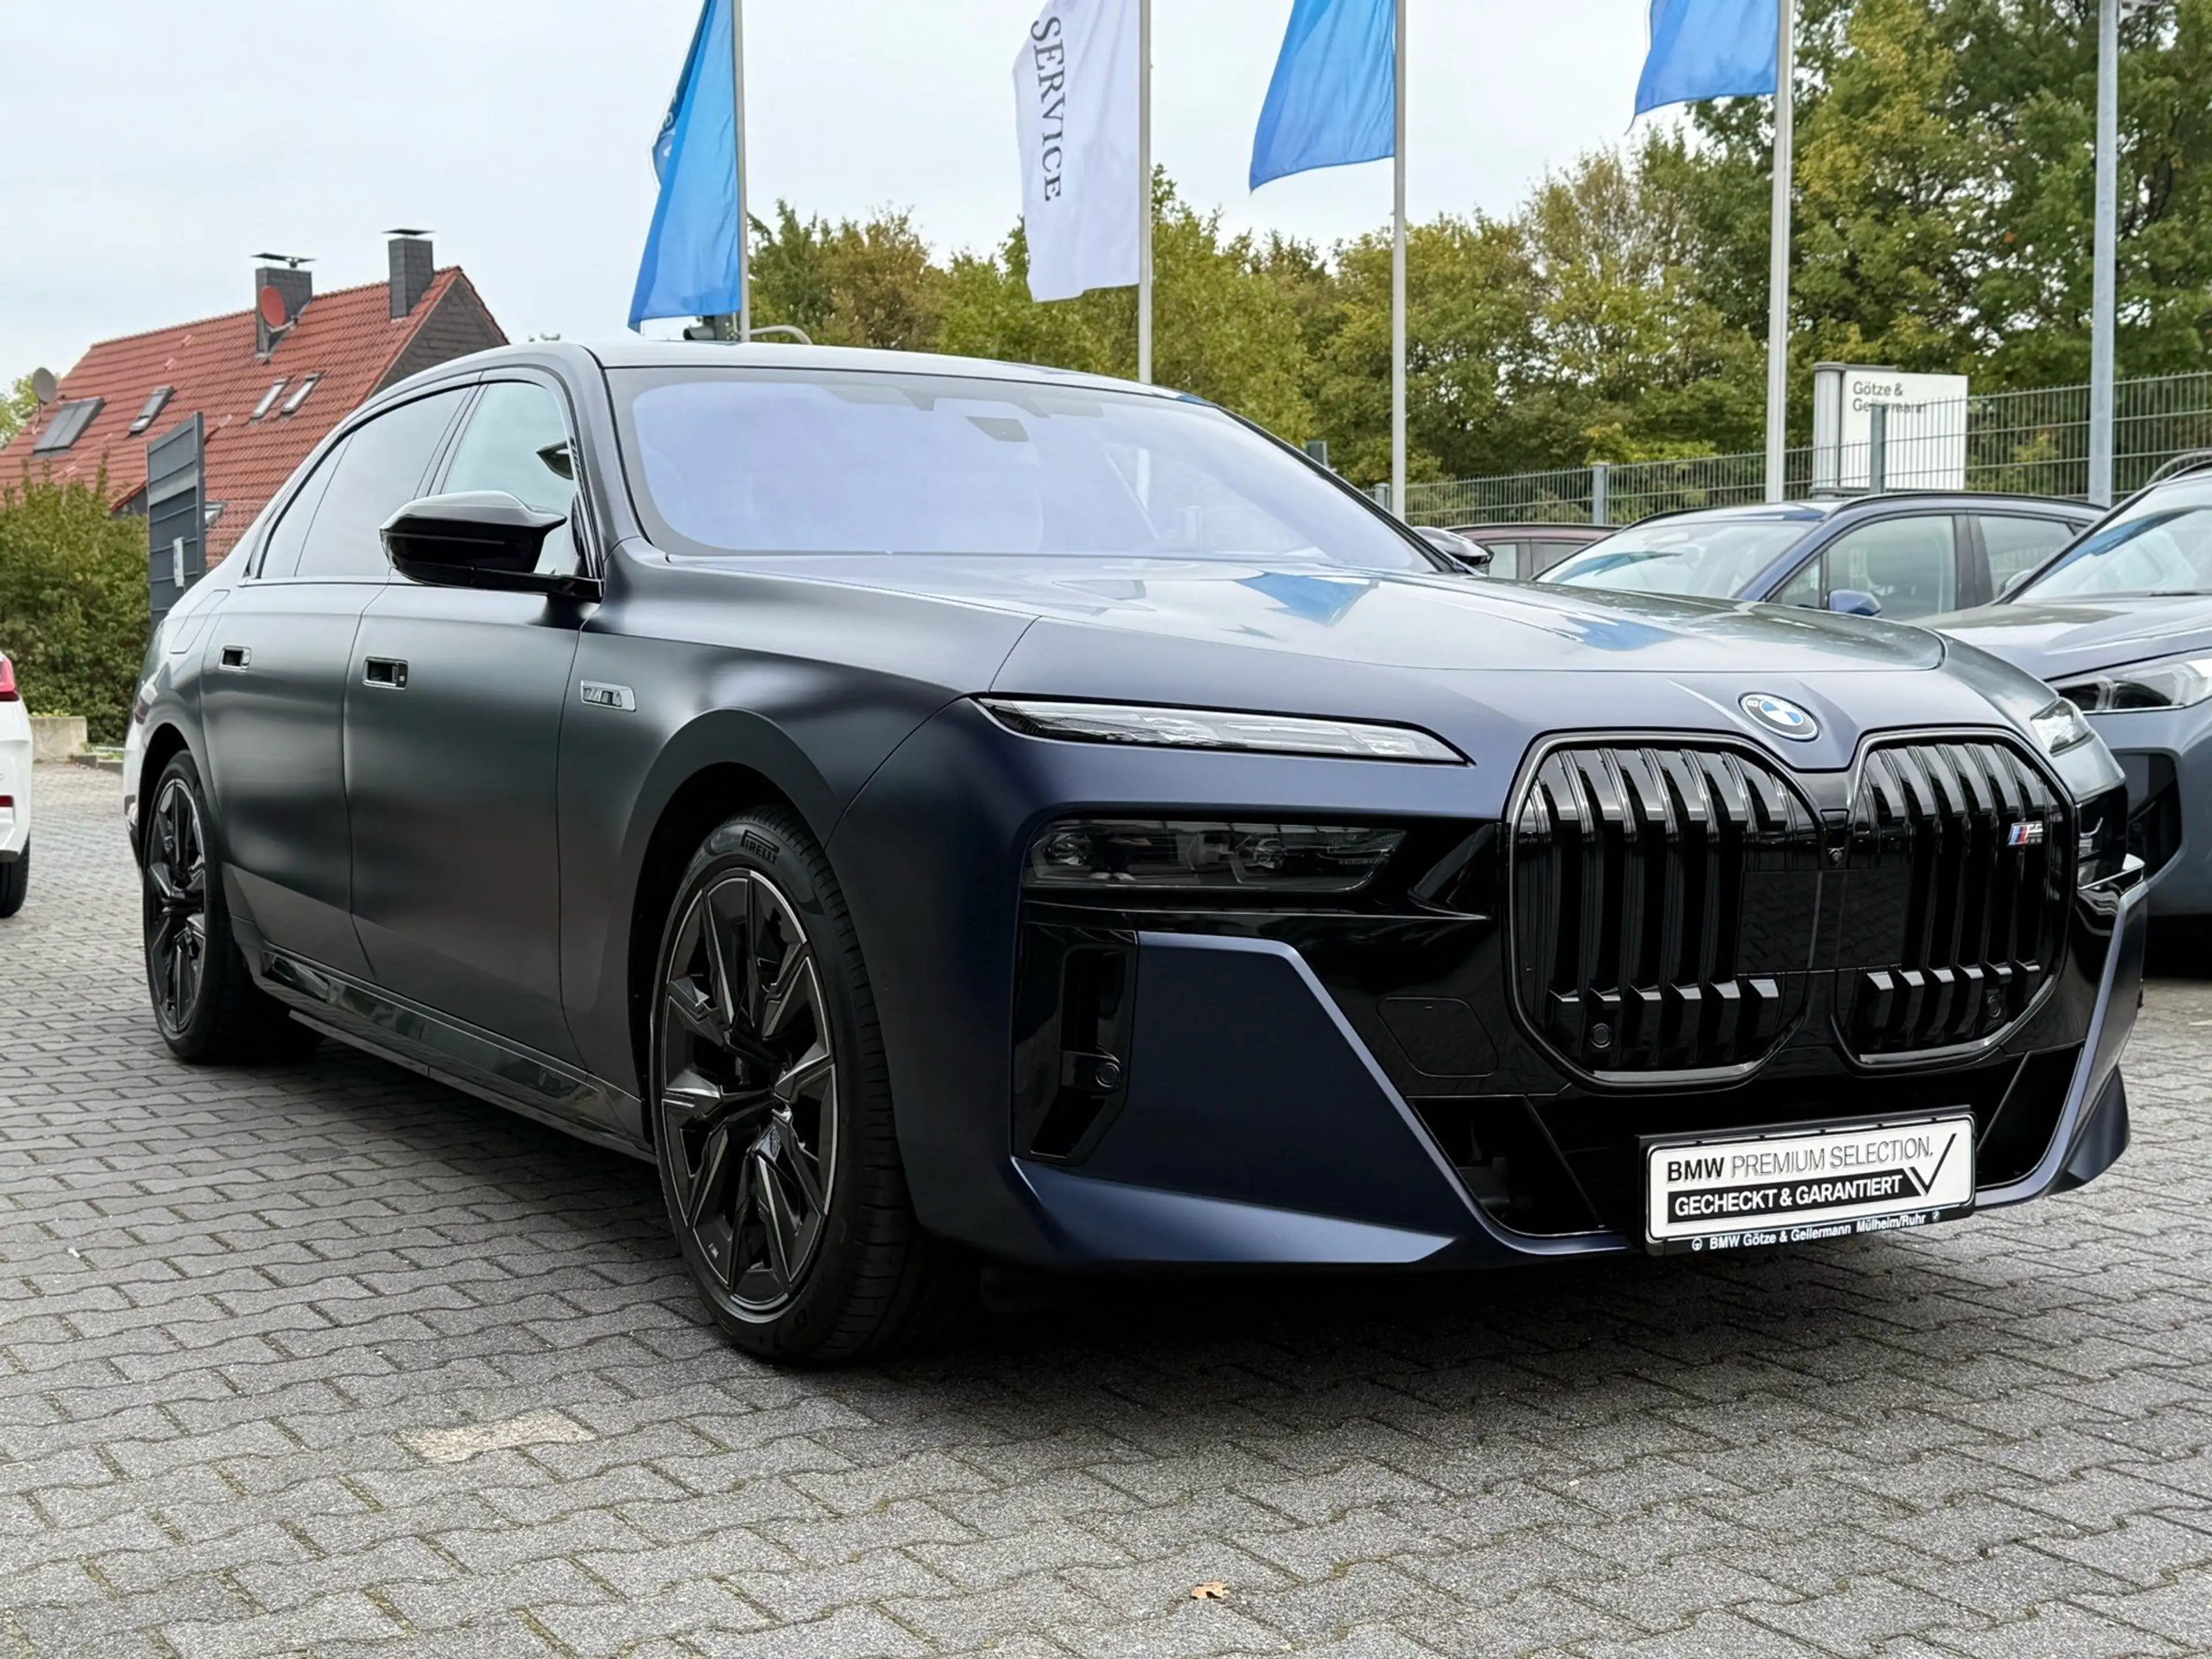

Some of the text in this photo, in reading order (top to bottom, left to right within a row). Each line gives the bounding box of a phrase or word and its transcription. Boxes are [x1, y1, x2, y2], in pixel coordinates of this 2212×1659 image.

[1030, 16, 1066, 202] SERVICE
[1853, 381, 1903, 396] Götze &
[740, 830, 780, 865] PIRELLI
[1667, 1157, 1724, 1182] BMW
[1730, 1148, 1825, 1179] PREMIUM
[1675, 1175, 1903, 1217] GECHECKT & GARANTIERT
[1709, 1214, 1926, 1250] BMW Götze & Gellermann Mülheim/Ruhr
